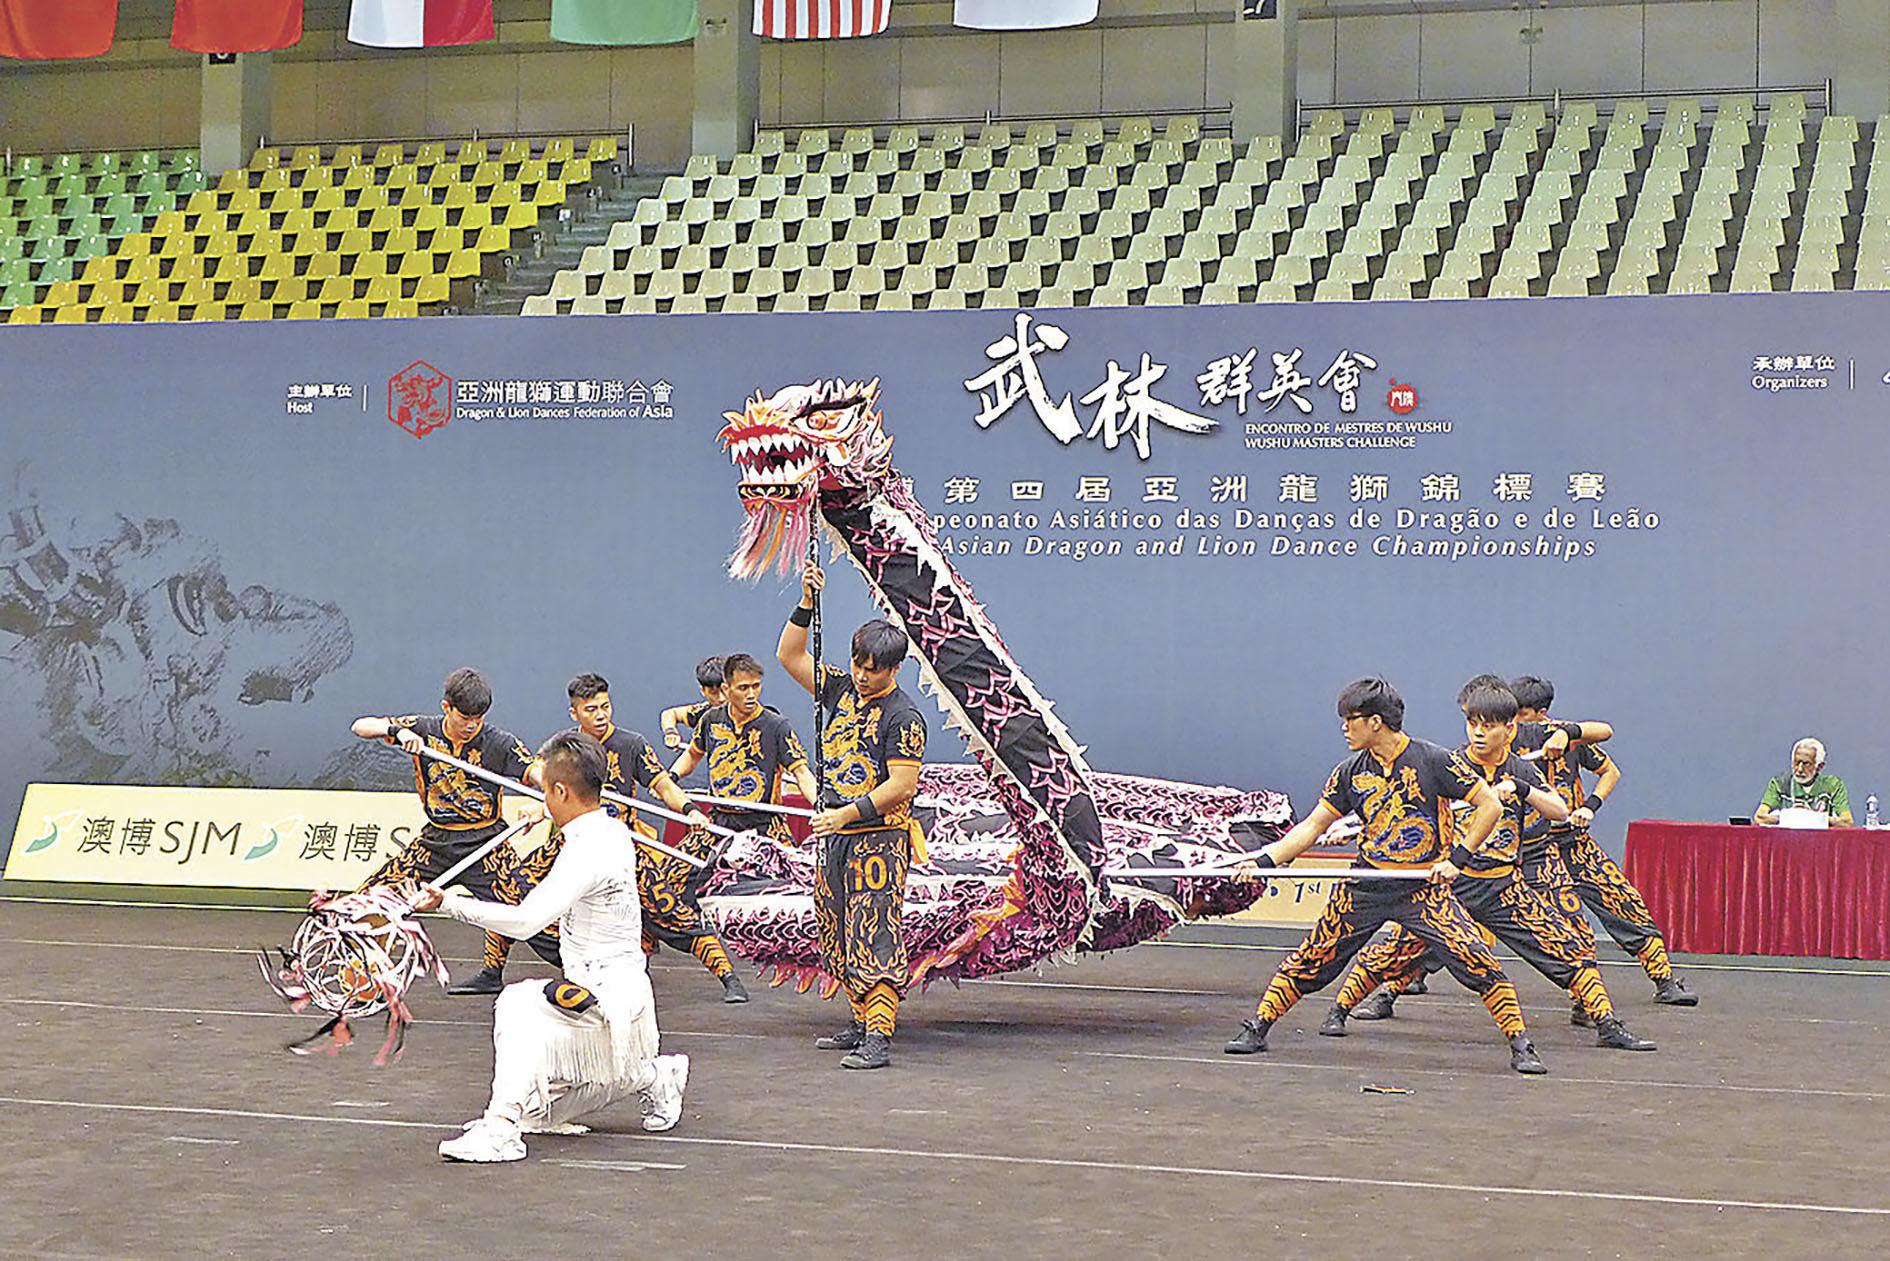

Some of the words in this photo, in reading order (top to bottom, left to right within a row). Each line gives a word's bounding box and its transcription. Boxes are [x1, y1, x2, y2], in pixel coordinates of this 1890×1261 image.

[1752, 355, 1836, 371] 承辦單位
[287, 383, 353, 399] 主辦單位
[456, 379, 674, 404] 亞洲龍獅運動聯合會
[1751, 374, 1828, 392] Organizers
[287, 402, 313, 414] Host
[456, 407, 494, 420] Dragon
[496, 406, 505, 418] &
[508, 406, 530, 418] Lion
[533, 407, 570, 418] Dances
[574, 406, 626, 418] Federation
[628, 406, 639, 418] of
[642, 405, 674, 418] Asia
[1245, 423, 1312, 434] ENCONTRO
[1314, 423, 1330, 434] DE
[1334, 422, 1384, 433] MESTRES
[1386, 422, 1403, 433] DE
[1405, 422, 1452, 433] WUSHU
[1245, 438, 1291, 448] WUSHU
[1293, 437, 1344, 448] MASTERS
[1346, 436, 1416, 448] CHALLENGE
[933, 511, 1039, 530] peonato
[1050, 507, 1163, 529] Asiático
[1176, 508, 1222, 529] das
[1234, 508, 1336, 533] Danças
[1349, 508, 1382, 529] de
[1396, 507, 1500, 534] Dragão
[1514, 513, 1529, 528] e
[1543, 508, 1578, 528] de
[1592, 508, 1660, 528] Leão
[942, 536, 1012, 555] Asian
[1025, 535, 1122, 561] Dragon
[1135, 535, 1183, 555] and
[1198, 535, 1255, 555] Lion
[1270, 536, 1358, 555] Dance
[1372, 535, 1597, 561] Championships
[849, 855, 888, 891] 10
[1601, 860, 1626, 885] 8
[652, 882, 675, 913] 5
[1559, 885, 1581, 912] 6
